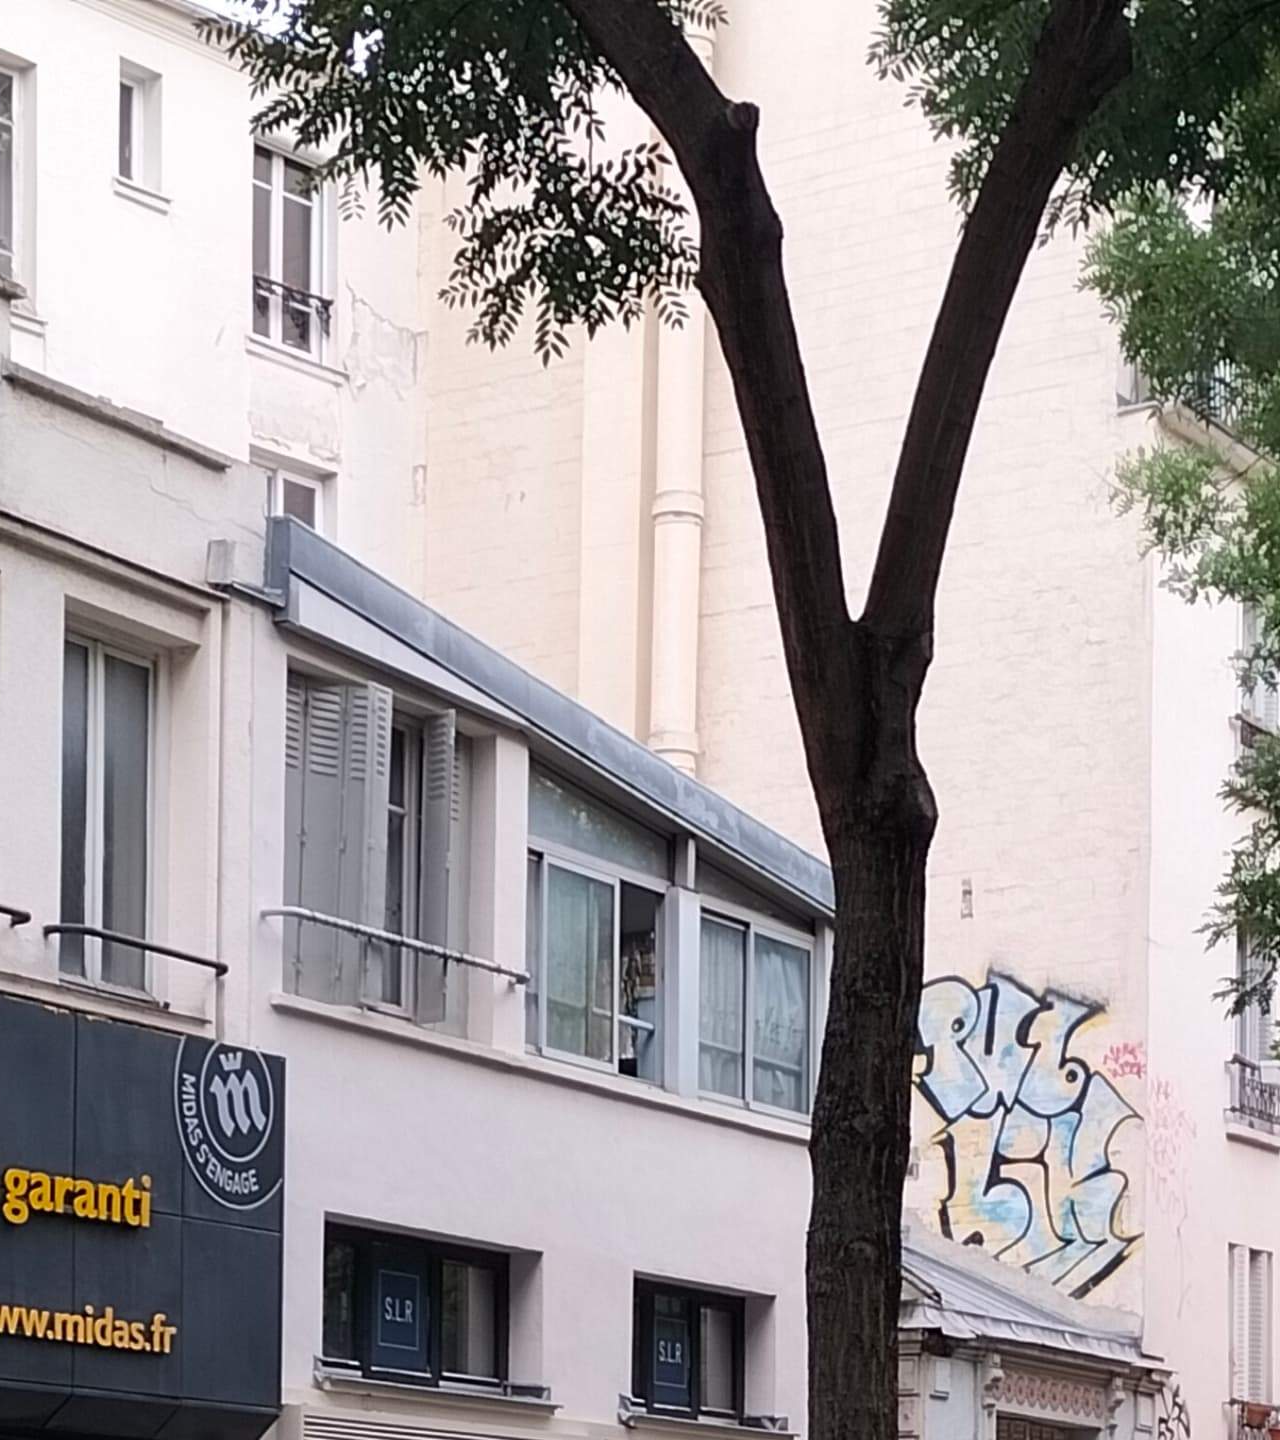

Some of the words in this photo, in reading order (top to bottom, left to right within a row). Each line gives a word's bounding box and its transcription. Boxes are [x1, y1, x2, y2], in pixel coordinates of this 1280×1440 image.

[181, 1073, 203, 1146] MIDAS
[195, 1143, 260, 1195] S'ENGAGE
[3, 1166, 152, 1228] garanti
